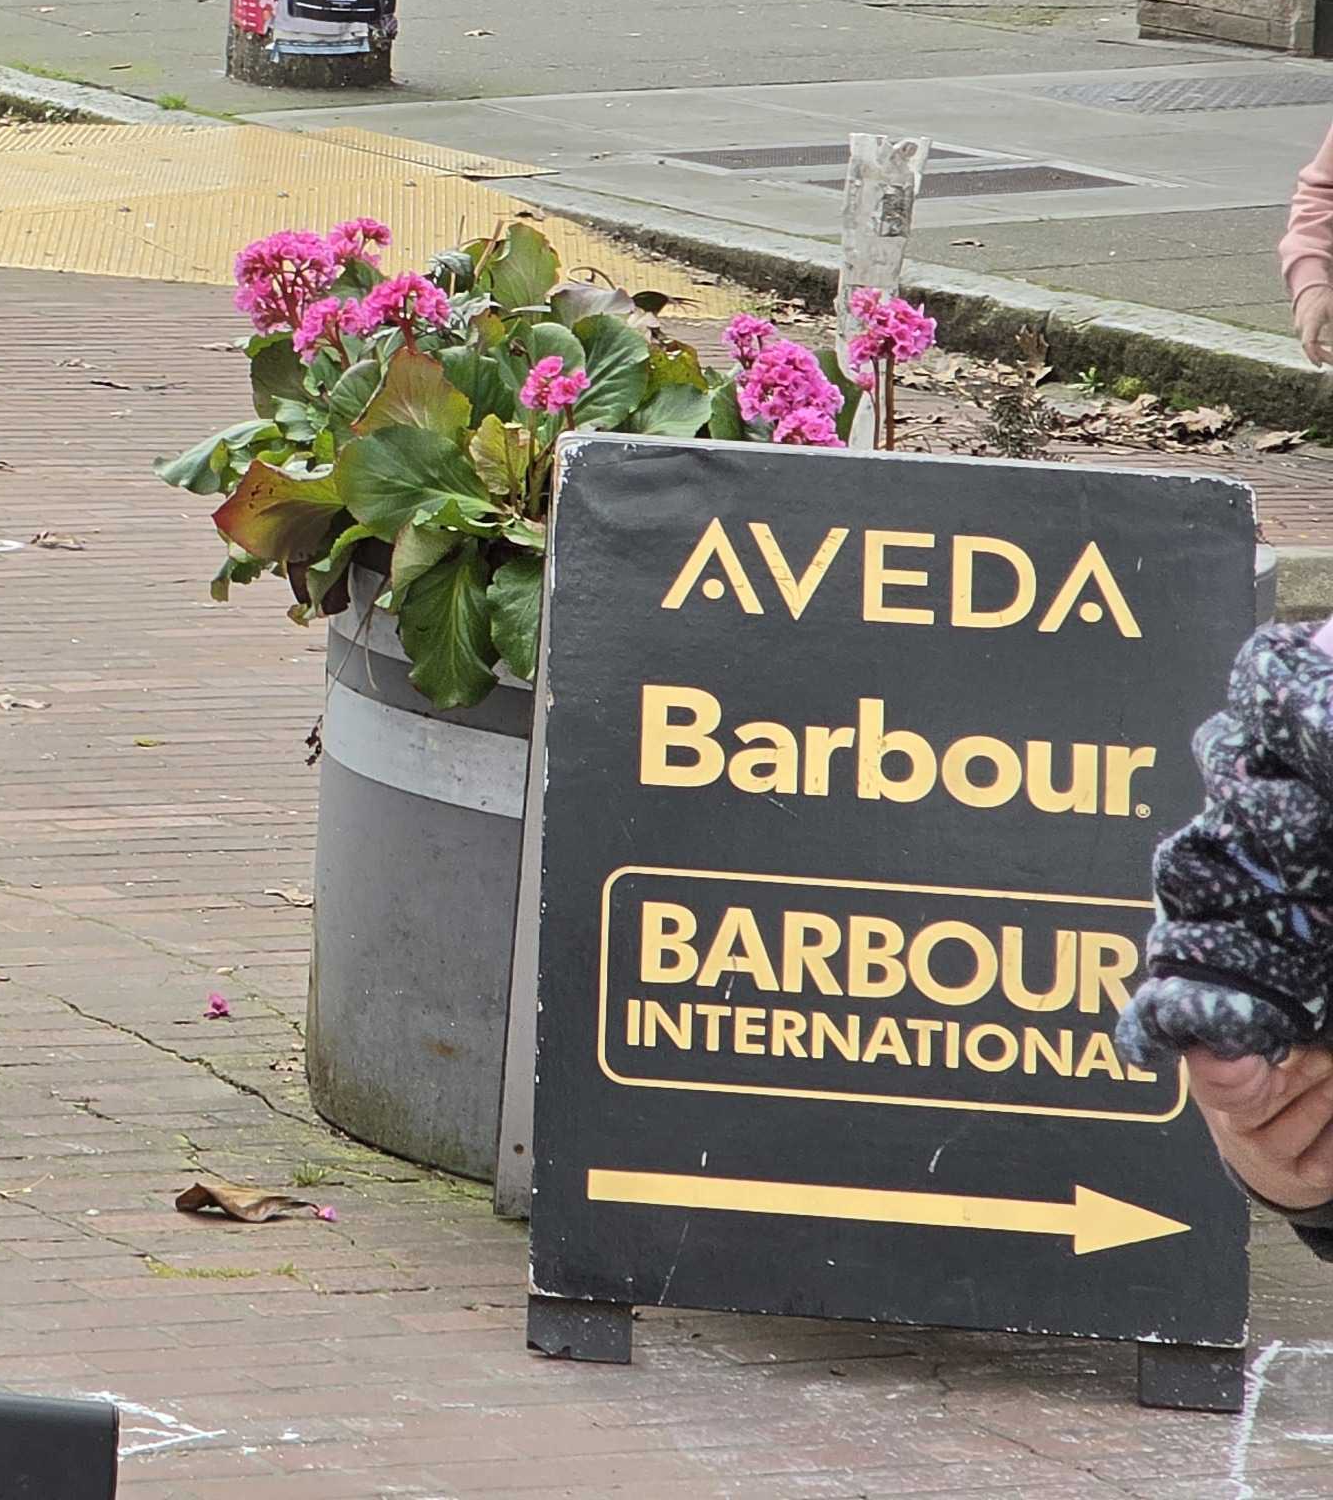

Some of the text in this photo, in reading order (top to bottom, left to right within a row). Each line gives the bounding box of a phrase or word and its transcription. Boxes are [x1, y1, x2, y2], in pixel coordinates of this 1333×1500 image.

[660, 516, 1143, 638] AVEDA
[640, 684, 1157, 818] Barbour
[640, 902, 1137, 1012] BARBOUR
